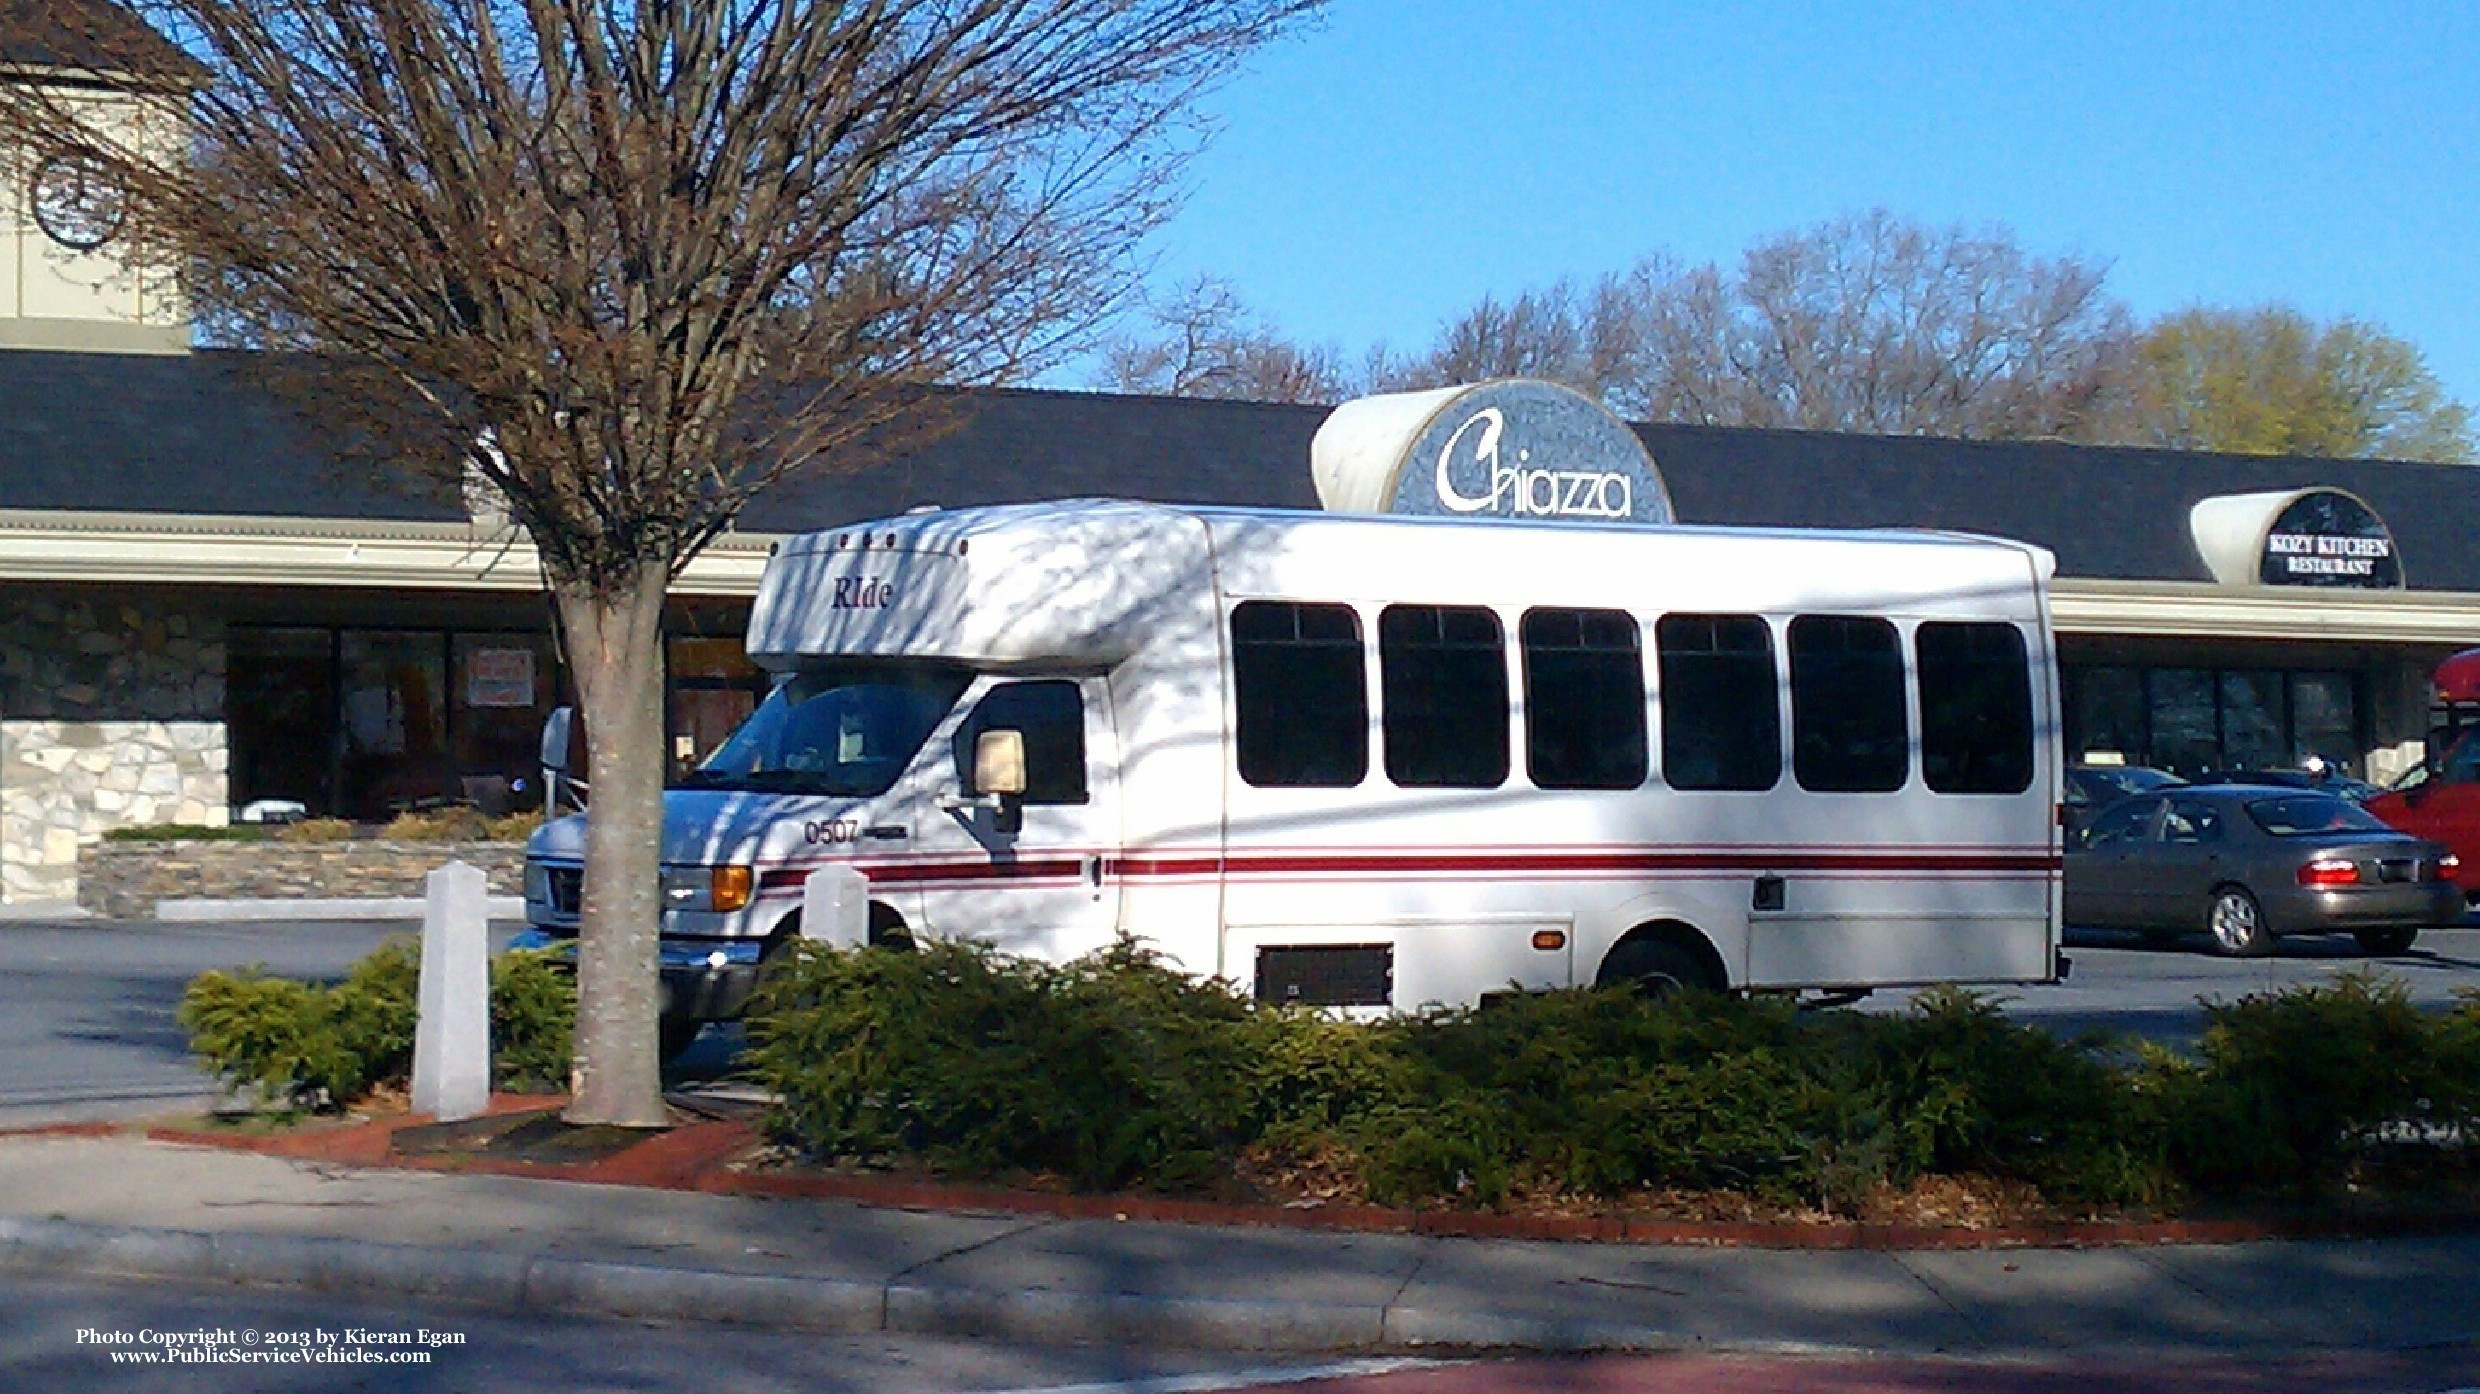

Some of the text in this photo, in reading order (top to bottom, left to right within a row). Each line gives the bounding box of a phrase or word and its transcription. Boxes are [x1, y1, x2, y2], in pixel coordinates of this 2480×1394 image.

[1436, 407, 1631, 517] Chiazza
[2269, 534, 2389, 557] KOZY KITCHEN
[2288, 556, 2375, 575] RESTAURANT
[803, 819, 859, 845] 0507
